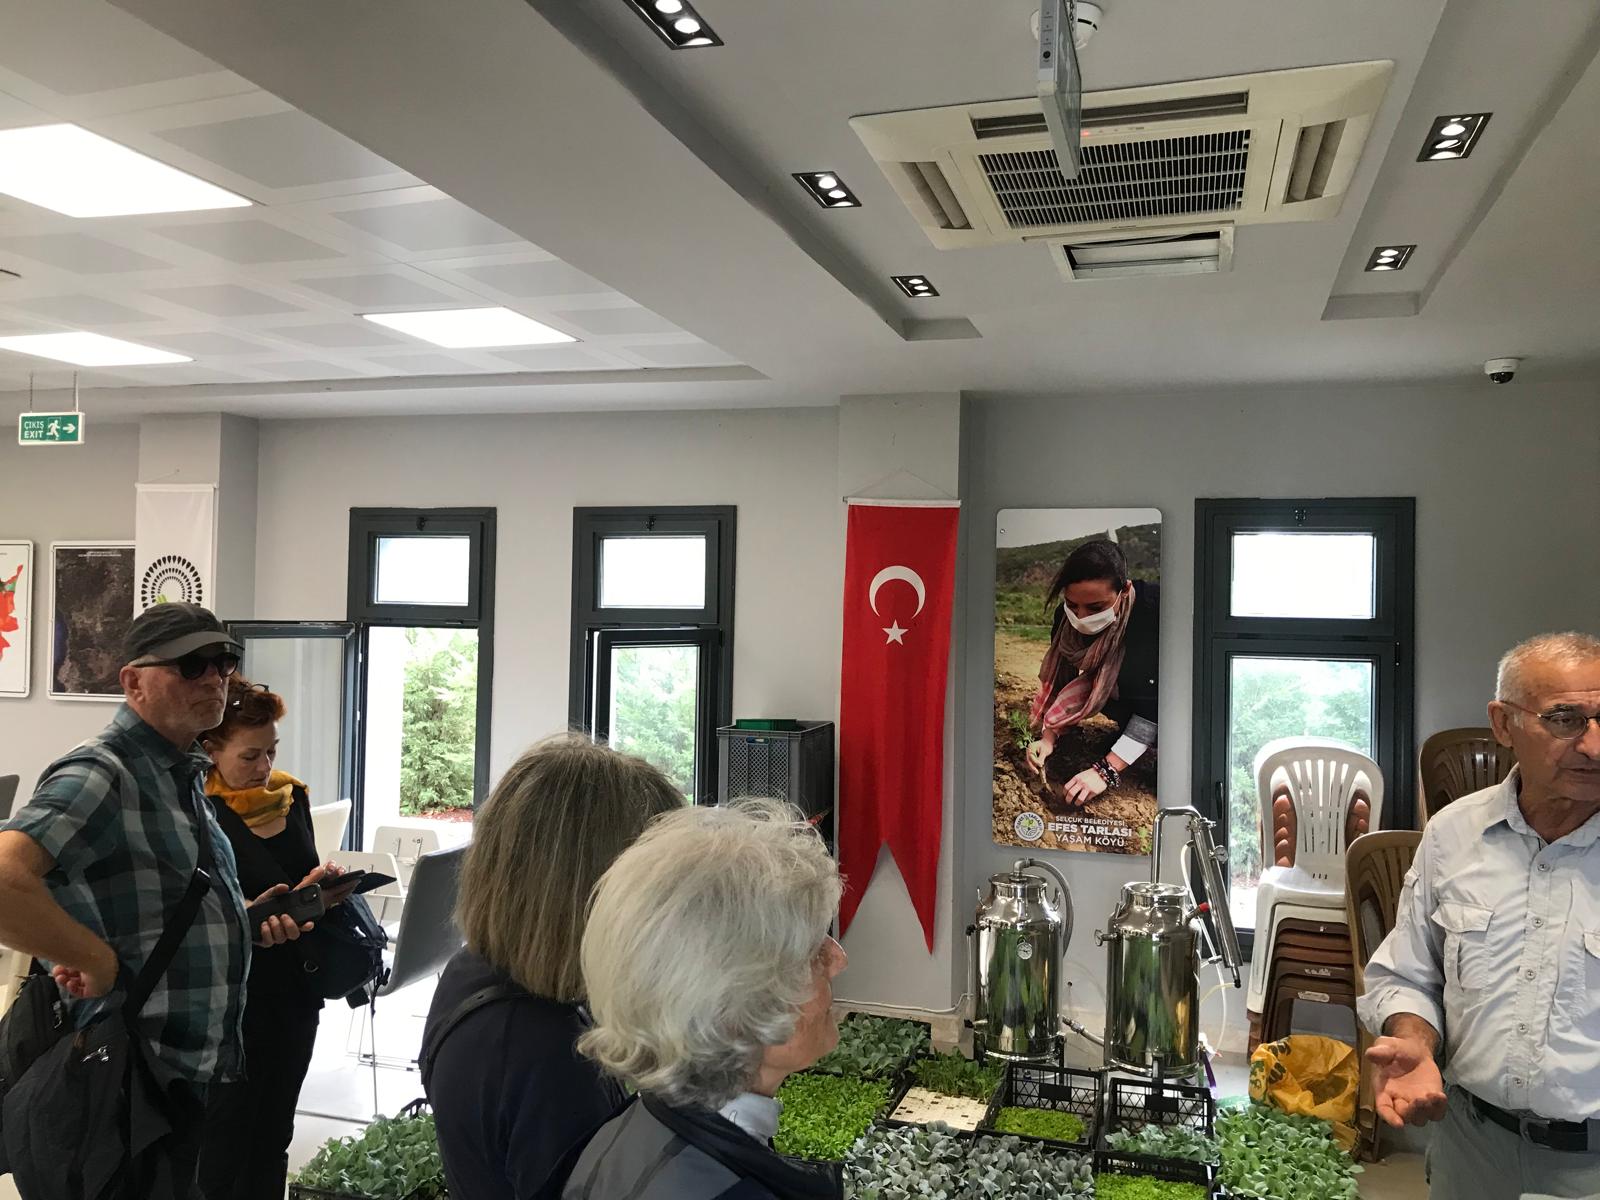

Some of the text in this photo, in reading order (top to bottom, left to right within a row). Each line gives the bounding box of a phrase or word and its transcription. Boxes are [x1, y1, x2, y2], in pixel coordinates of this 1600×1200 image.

[24, 431, 43, 439] EXIT
[1056, 816, 1083, 824] SELÇUK
[1048, 822, 1132, 837] EFES TARLASI
[1056, 834, 1125, 847] YAŞAM KÖYÜ
